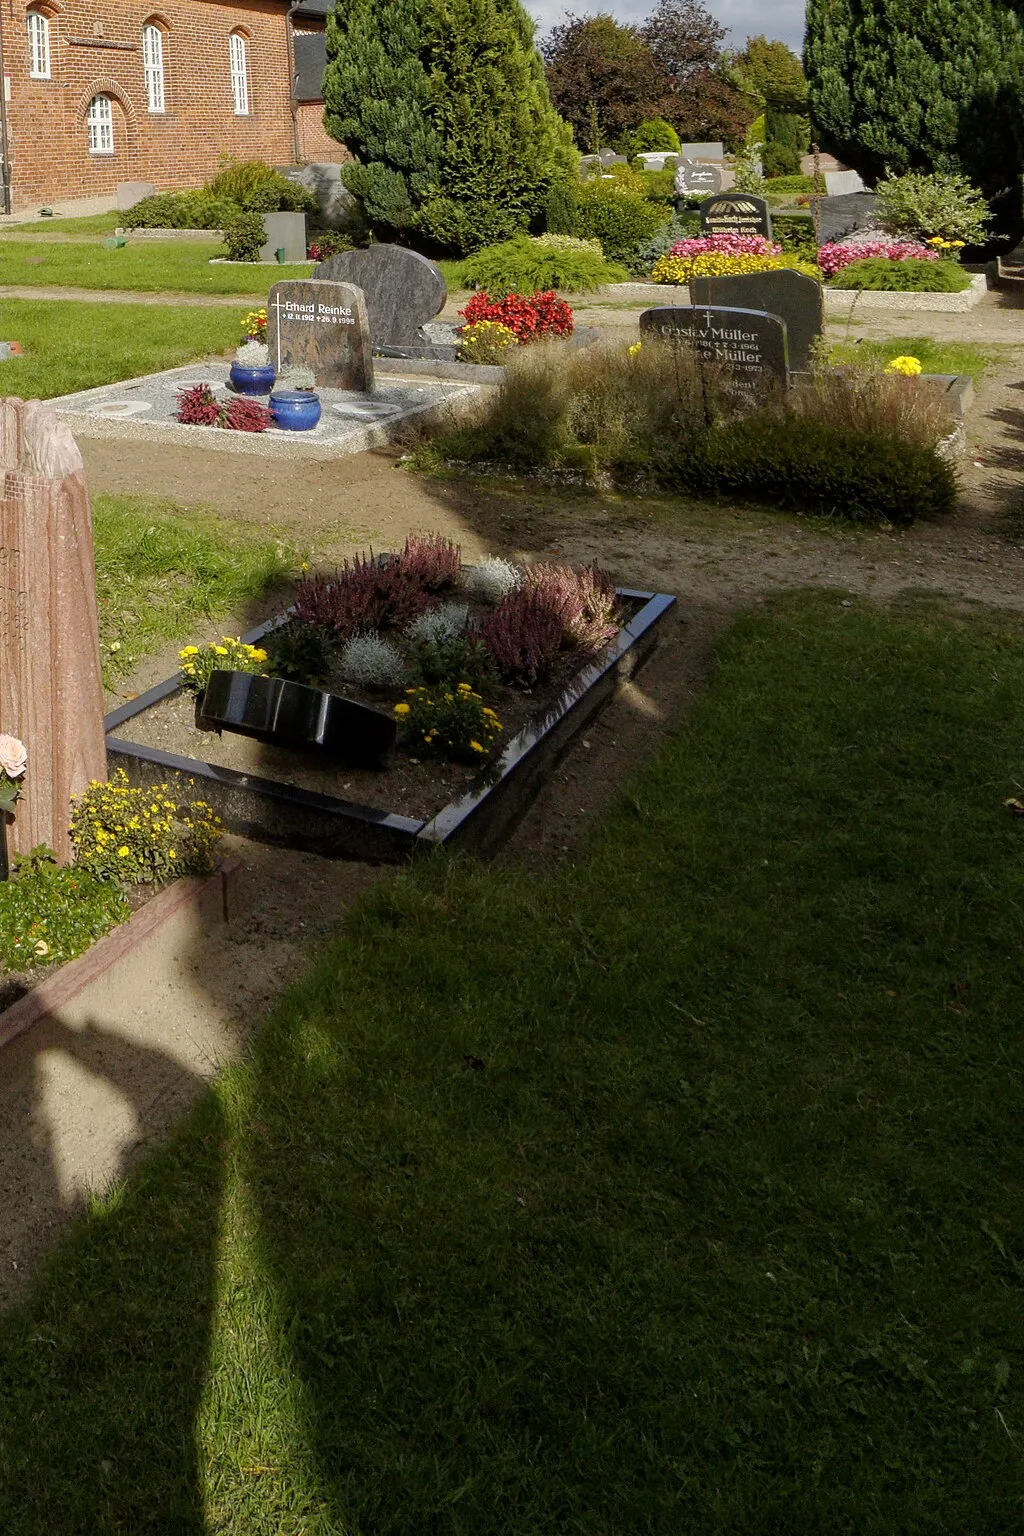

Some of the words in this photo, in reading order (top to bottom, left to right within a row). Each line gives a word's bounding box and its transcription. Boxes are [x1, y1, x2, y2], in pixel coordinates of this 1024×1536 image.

[285, 301, 315, 313] Erhard
[318, 304, 352, 316] Reinke
[711, 327, 759, 341] Müller
[716, 348, 763, 363] Müller
